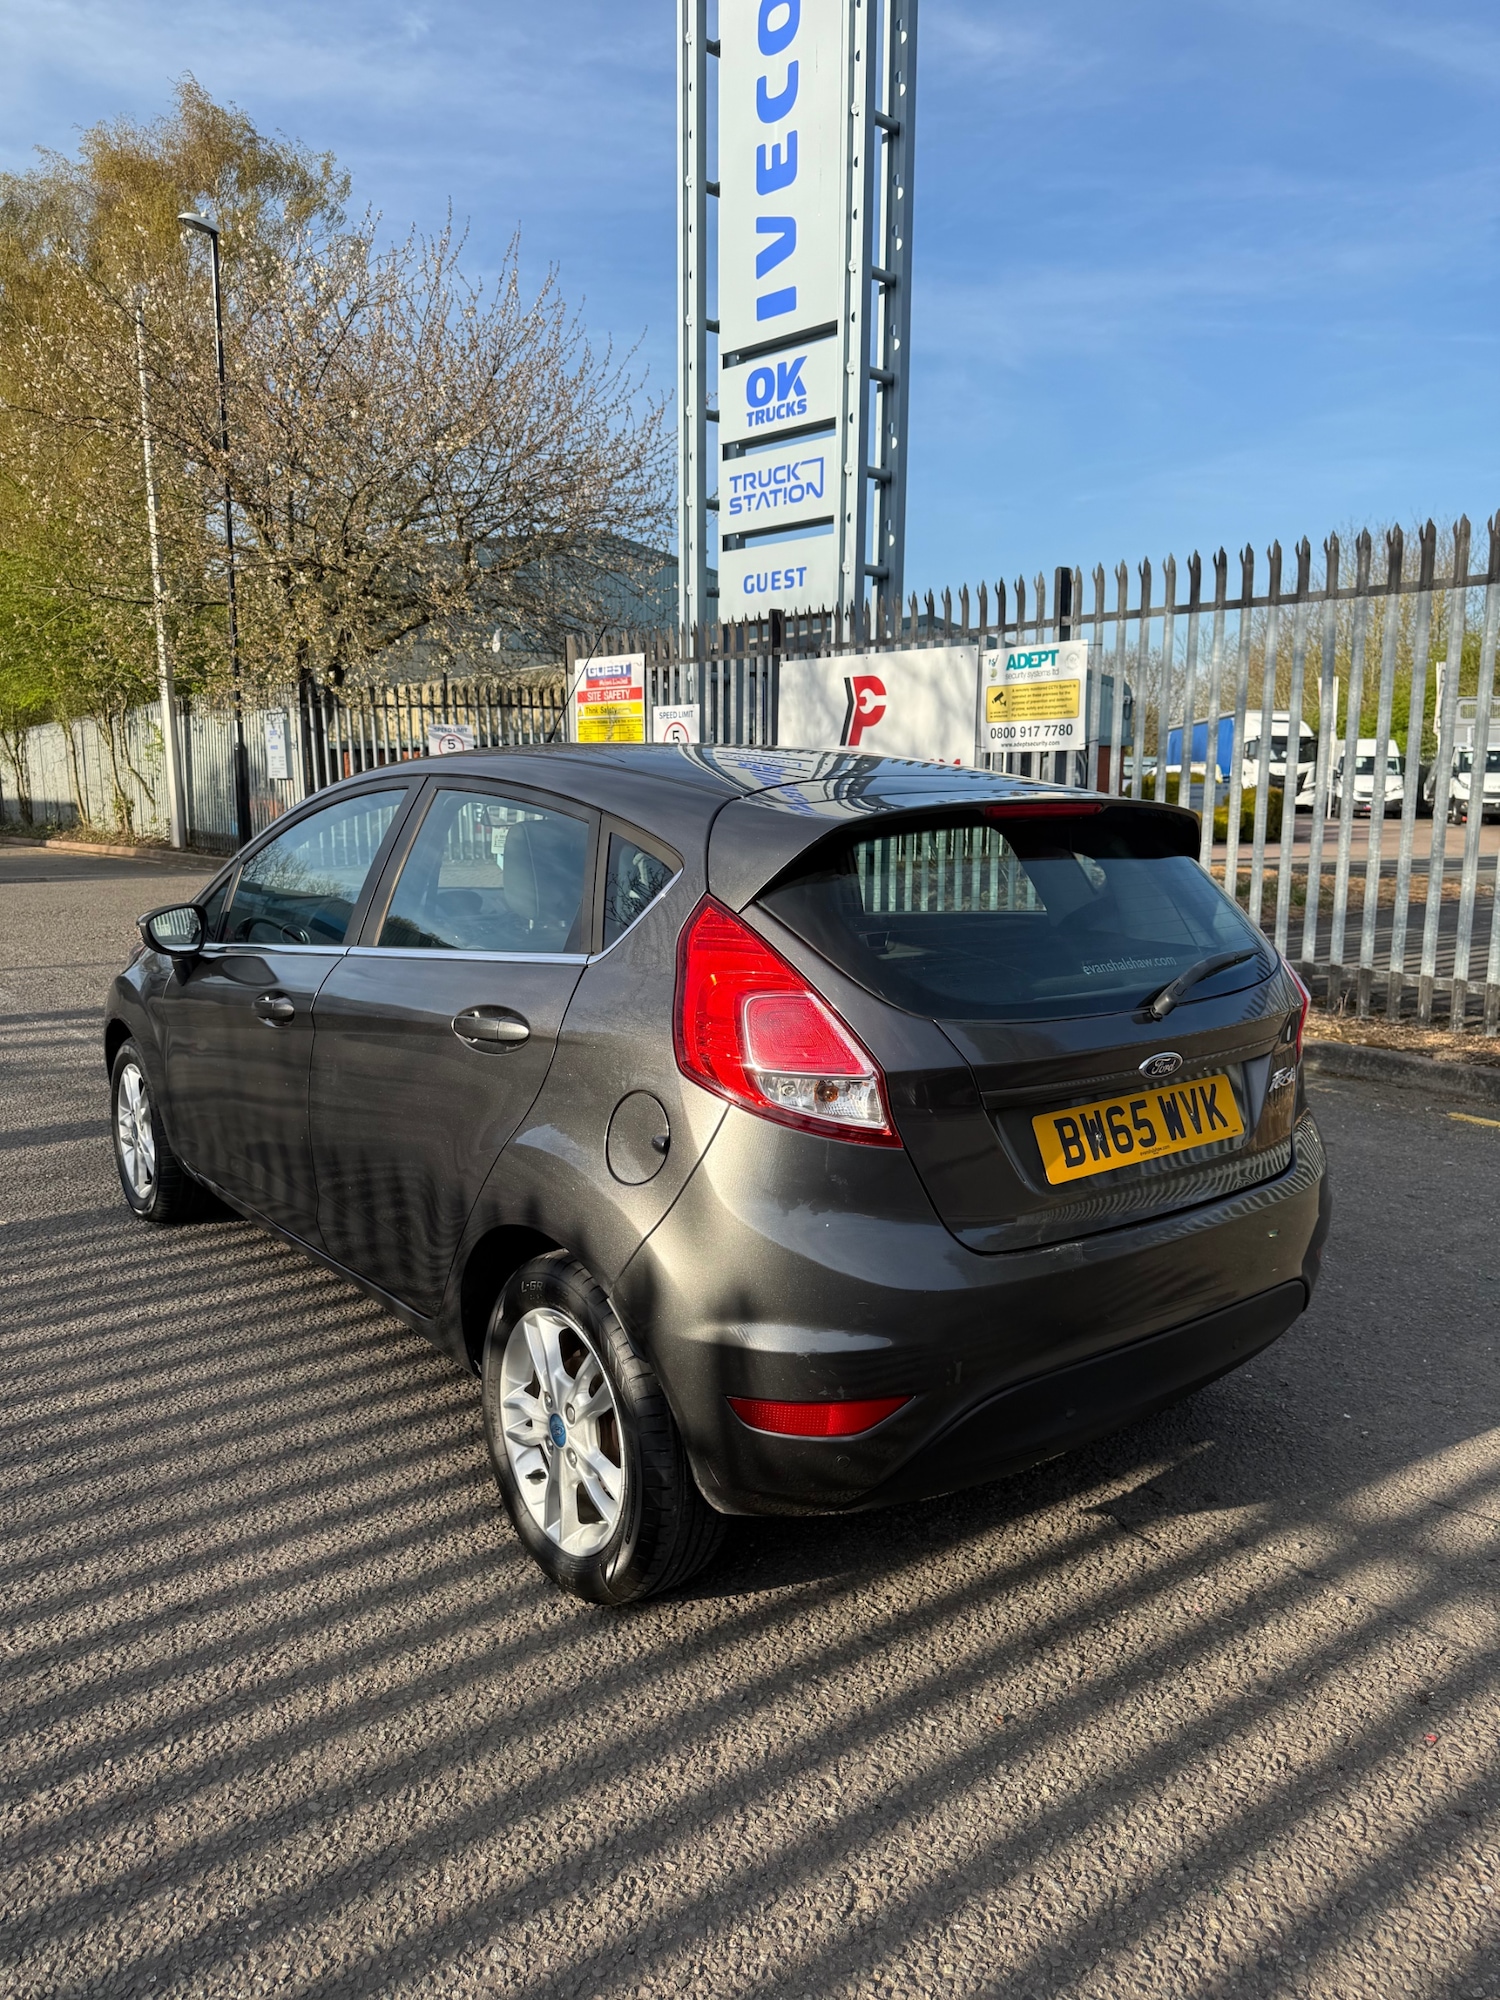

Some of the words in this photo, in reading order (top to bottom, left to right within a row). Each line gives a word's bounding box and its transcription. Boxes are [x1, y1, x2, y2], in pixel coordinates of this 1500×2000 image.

[756, 0, 800, 321] IVECO
[746, 355, 807, 408] OK
[746, 398, 807, 427] TRUCKS
[729, 461, 801, 494] TRUCK
[729, 481, 824, 515] STATION
[743, 566, 807, 594] GUEST
[587, 663, 629, 677] GUEST
[1005, 649, 1060, 671] ADEPT
[1005, 671, 1026, 680] security
[1027, 670, 1051, 679] systems
[587, 691, 602, 702] SITE
[603, 689, 631, 701] SAFETY
[659, 711, 678, 719] SPEED
[678, 710, 694, 718] LIMIT
[672, 730, 680, 743] 5
[990, 726, 1016, 739] 0800
[1019, 725, 1040, 738] 917
[1044, 723, 1073, 736] 7780
[447, 739, 456, 750] 5
[1083, 956, 1177, 975] evanshalshaw.com
[1054, 1099, 1157, 1168] BW65
[1157, 1083, 1229, 1141] WVK
